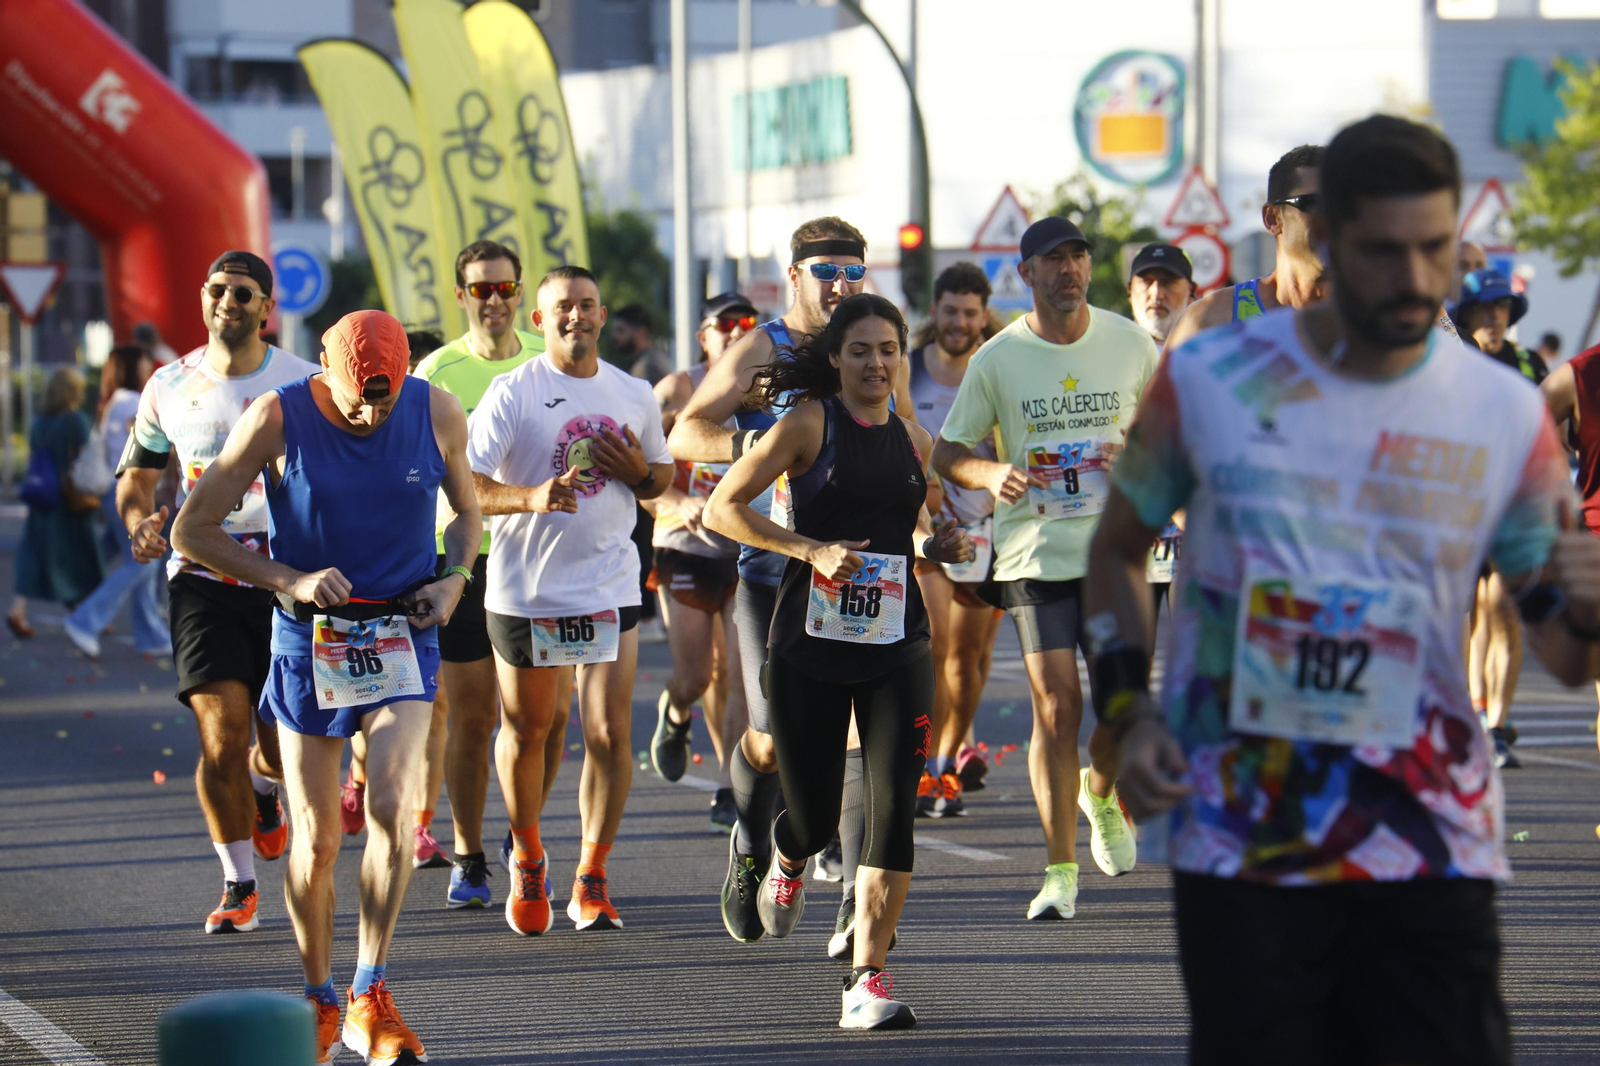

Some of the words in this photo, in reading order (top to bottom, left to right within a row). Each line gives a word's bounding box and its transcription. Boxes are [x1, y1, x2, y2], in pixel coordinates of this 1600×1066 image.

[1022, 399, 1048, 420] MIS
[1052, 391, 1120, 415] CALERITOS
[1036, 418, 1065, 433] ESTÁN
[1068, 416, 1112, 429] CONMIGO
[1370, 428, 1489, 488] MEDIA
[1063, 467, 1080, 495] 9
[839, 583, 881, 618] 158
[556, 615, 595, 643] 156
[345, 647, 383, 678] 96
[1295, 637, 1372, 696] 192
